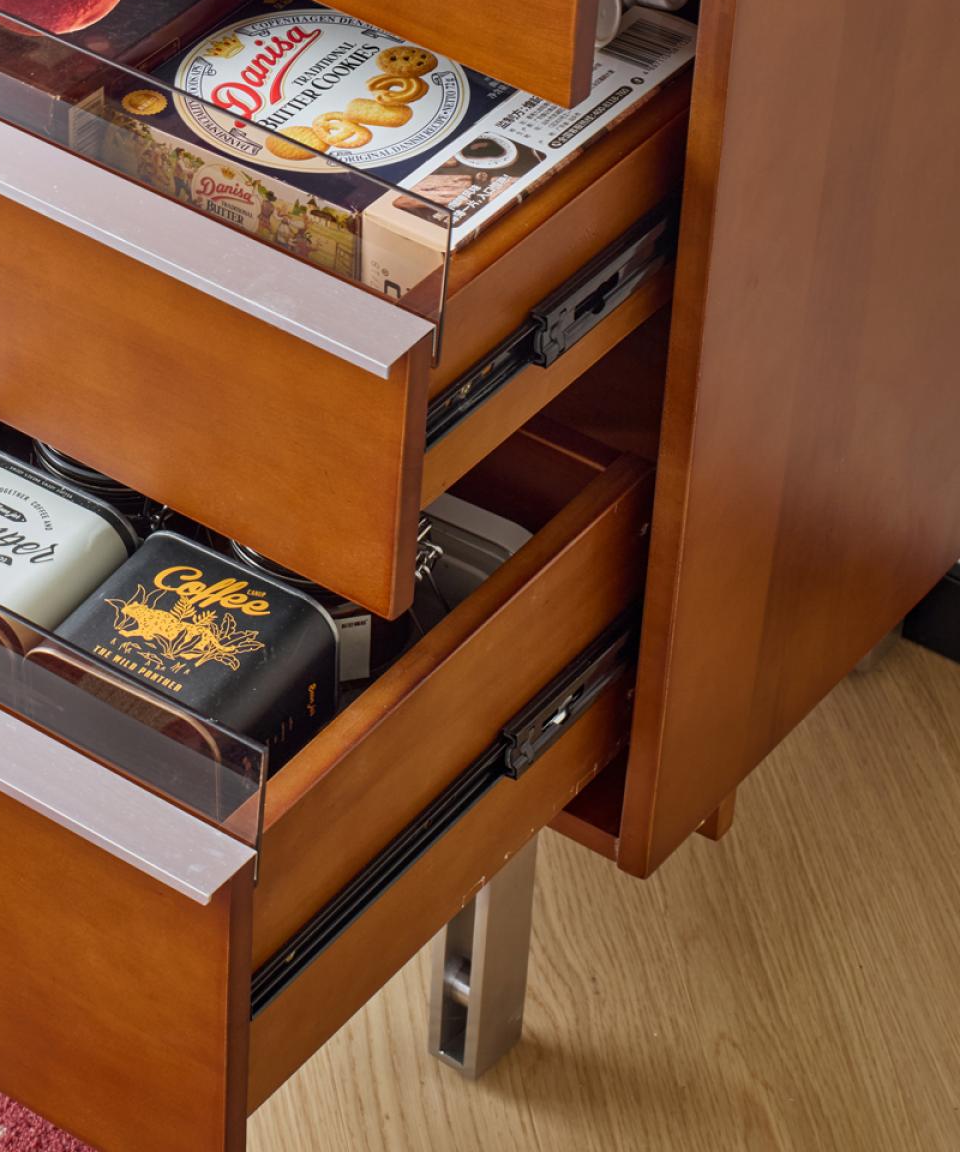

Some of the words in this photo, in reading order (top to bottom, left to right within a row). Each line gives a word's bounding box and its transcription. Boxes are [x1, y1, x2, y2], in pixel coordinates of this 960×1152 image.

[251, 15, 336, 31] COPENHAGEN
[211, 25, 322, 128] Danisa
[257, 85, 323, 132] BUTTER
[311, 42, 381, 98] COOKIES
[292, 41, 358, 88] TRADITIONAL
[340, 150, 392, 163] ORIGINAL
[391, 133, 427, 153] DANISH
[425, 114, 449, 138] RECIPE
[443, 89, 458, 113] NETTO
[195, 176, 254, 205] Danisa
[206, 199, 244, 224] BUTTER
[30, 500, 50, 519] COFFEE
[153, 565, 271, 616] Coffee
[93, 644, 109, 657] THE
[112, 653, 138, 670] WILD
[138, 667, 184, 693] PANTHER
